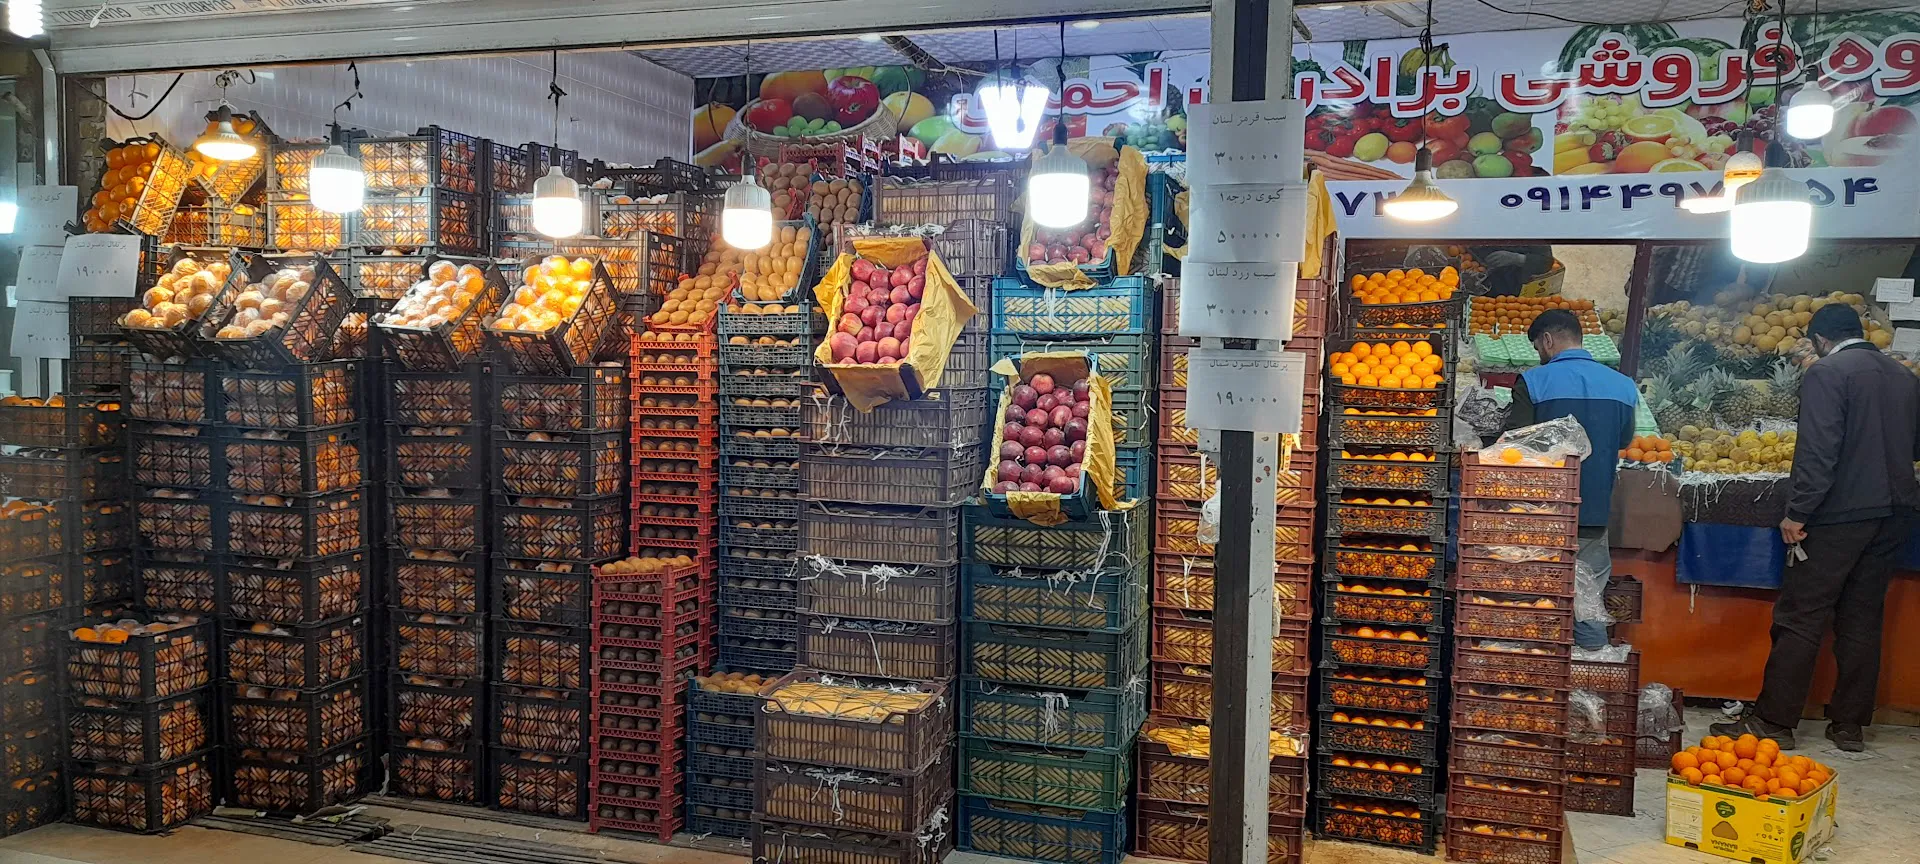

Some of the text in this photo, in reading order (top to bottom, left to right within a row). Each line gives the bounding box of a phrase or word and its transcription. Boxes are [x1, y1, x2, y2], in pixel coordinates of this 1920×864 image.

[1501, 27, 1797, 107] فروشی
[1828, 38, 1920, 90] وه
[1212, 112, 1287, 126] سیب قرمز لبنان
[1214, 151, 1279, 165] ۳۰۰۰۰۰
[1255, 188, 1284, 203] کیوی
[1500, 177, 1879, 212] ۰۹۱۴۴۹۷۵۴
[1217, 230, 1280, 243] ۵۰۰۰۰۰
[76, 265, 118, 277] ۱۹۰۰۰۰
[1207, 267, 1276, 281] سیب زرد لبنان
[1206, 303, 1269, 317] ۳۰۰۰۰۰
[1263, 359, 1288, 371] پرتقال
[1216, 390, 1278, 405] ۱۹۰۰۰۰
